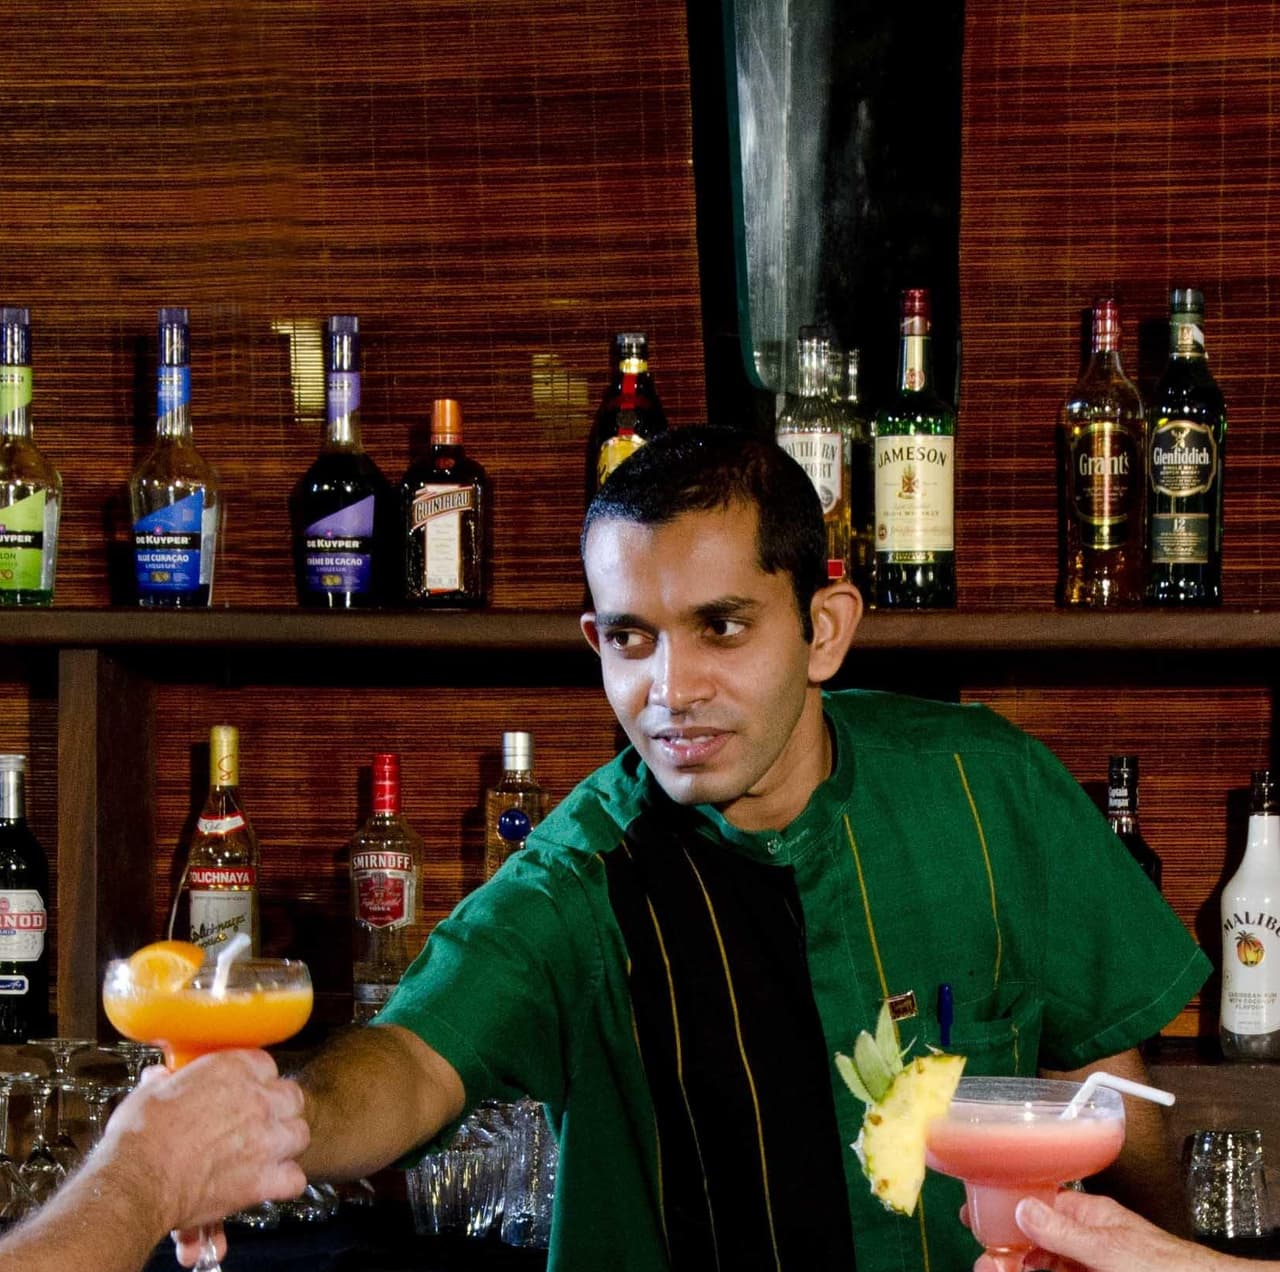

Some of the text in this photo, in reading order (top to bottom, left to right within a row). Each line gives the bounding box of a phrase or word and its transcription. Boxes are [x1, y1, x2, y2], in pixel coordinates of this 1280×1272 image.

[784, 440, 837, 461] OUTHRN
[878, 446, 947, 468] JAMESON
[1154, 447, 1209, 465] Glenfiddich
[1080, 451, 1129, 476] Grant's
[415, 492, 469, 523] COINTREAU
[1173, 518, 1186, 531] 12
[146, 536, 188, 545] KUYPER
[317, 539, 359, 548] KUYPER
[151, 554, 189, 563] CURAÇAO
[335, 558, 362, 566] CACAO
[353, 855, 411, 869] SMIRNOFF
[192, 872, 249, 884] OLICHNAYA
